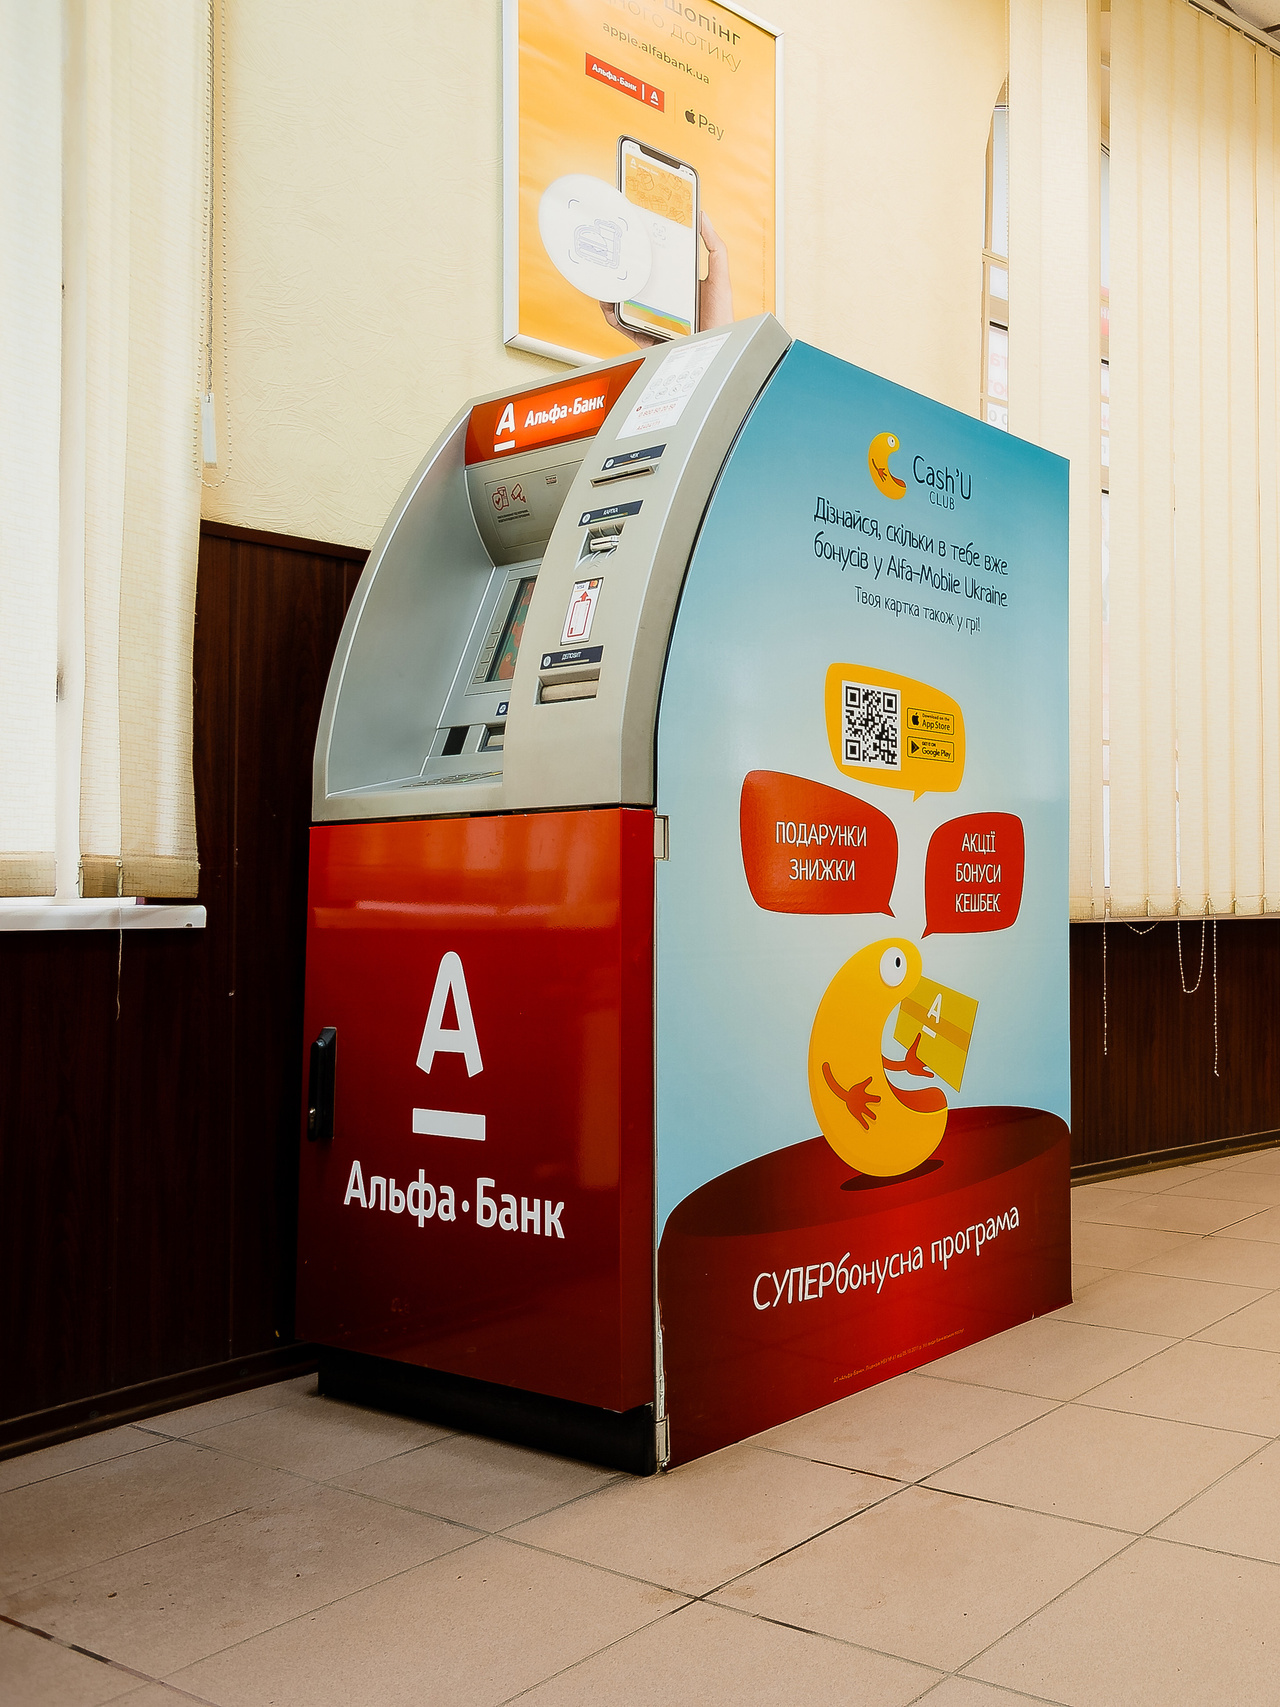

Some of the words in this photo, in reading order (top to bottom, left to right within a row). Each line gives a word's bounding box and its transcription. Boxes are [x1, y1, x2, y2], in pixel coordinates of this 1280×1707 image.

[602, 22, 710, 84] apple.alfabank.ua
[670, 23, 742, 73] дотику
[698, 113, 725, 141] Pay
[929, 491, 956, 511] CLUB
[813, 496, 882, 541] Дізнайся,
[886, 523, 935, 554] скільки
[938, 540, 946, 557] в
[950, 541, 981, 567] тебе
[984, 554, 1009, 576] вже
[813, 530, 869, 572] бонусів
[873, 555, 883, 580] у
[964, 575, 1009, 608] Ukraine
[854, 585, 881, 609] Твоя
[884, 597, 920, 618] картка
[922, 606, 954, 626] також
[956, 615, 963, 632] у
[965, 616, 981, 635] грі!
[922, 719, 935, 730] App
[935, 721, 950, 731] Store
[922, 746, 940, 758] Google
[941, 749, 951, 759] Play
[775, 821, 867, 848] ПОДАРУНКИ
[961, 831, 996, 855] АКЦІЇ
[788, 858, 856, 882] ЗНИЖКИ
[955, 863, 1002, 884] БОНУСИ
[955, 893, 1001, 913] КЕШБЕК
[752, 1246, 924, 1311] СУПЕРбонусна
[931, 1206, 1020, 1271] програма
